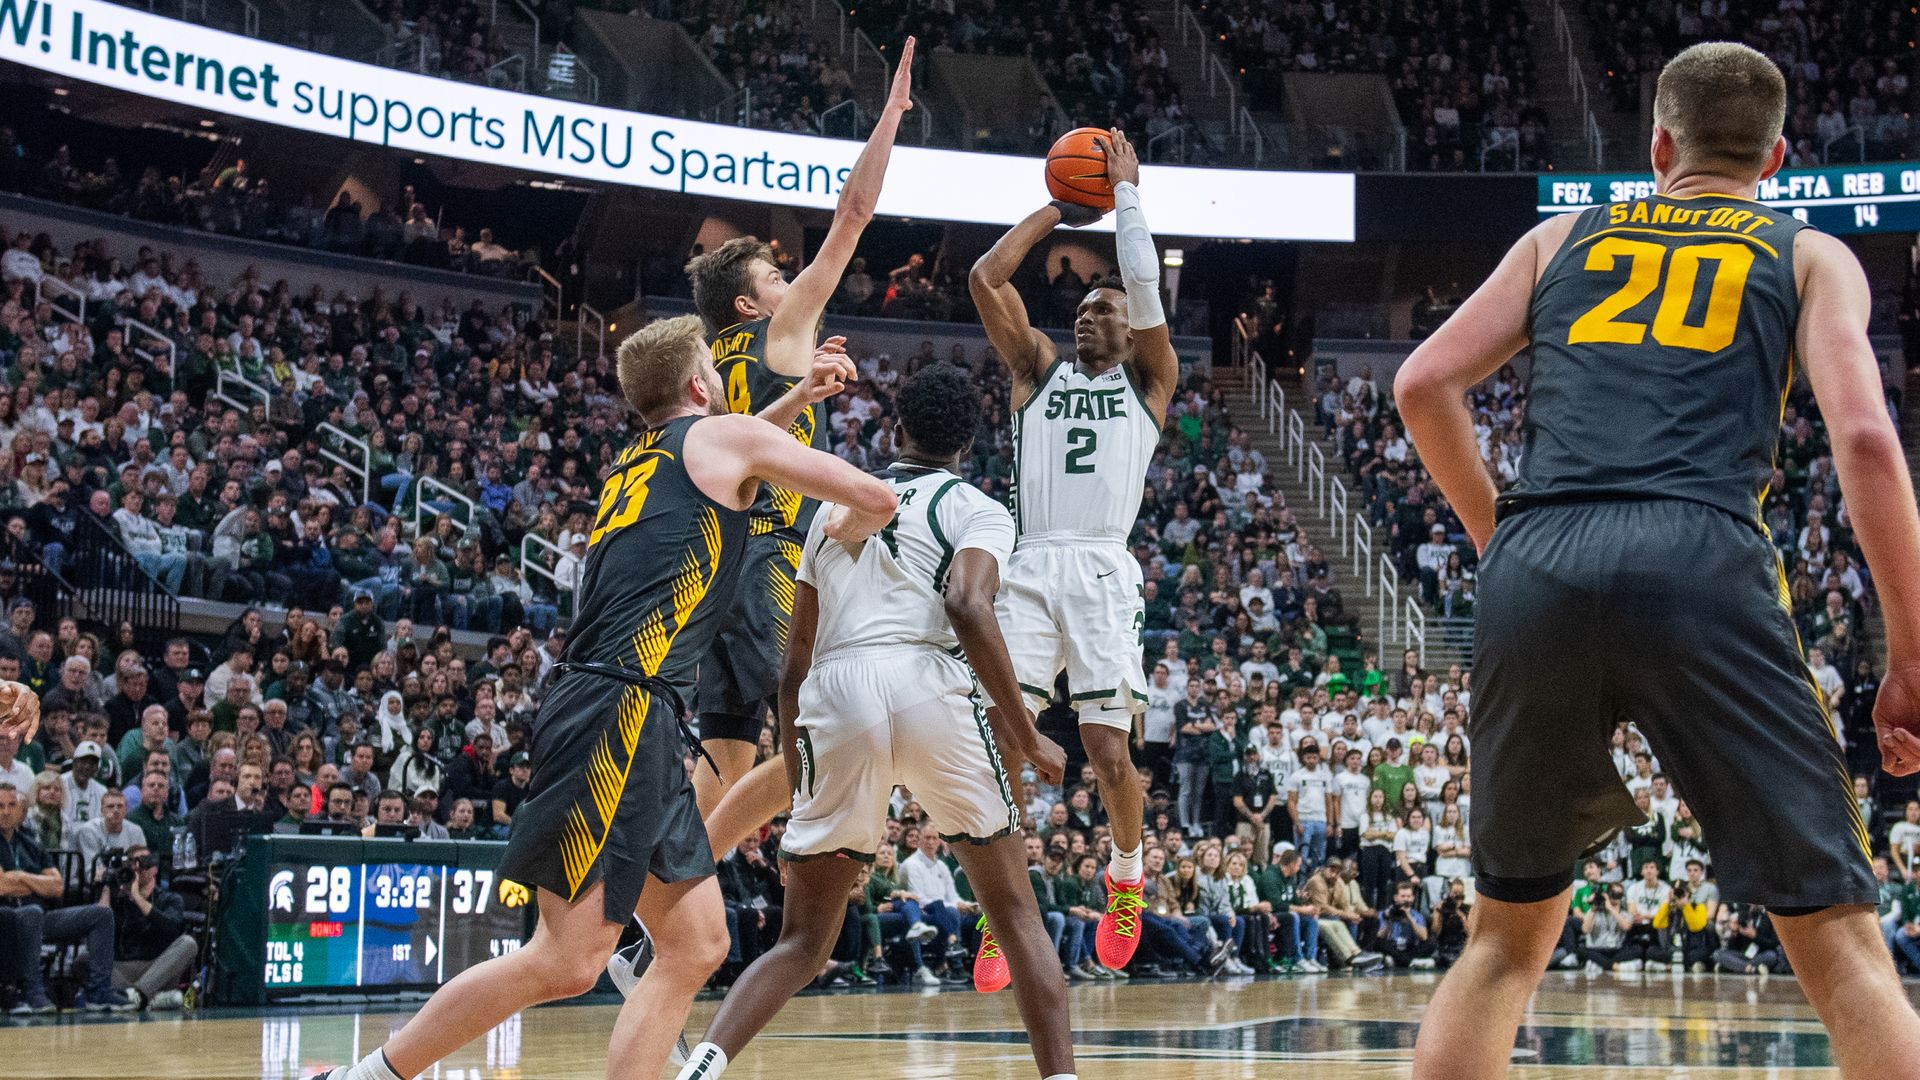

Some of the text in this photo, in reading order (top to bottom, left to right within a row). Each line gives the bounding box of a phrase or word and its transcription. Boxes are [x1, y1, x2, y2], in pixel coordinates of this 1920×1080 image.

[71, 11, 280, 107] Internet
[293, 81, 505, 149] supports
[523, 110, 632, 168] MSU
[1552, 182, 1593, 204] FG%
[1843, 172, 1884, 196] REB
[1854, 204, 1879, 227] 14
[1567, 236, 1756, 353] 20
[1044, 386, 1128, 421] STATE
[1065, 427, 1097, 474] 2
[588, 456, 659, 548] 23
[306, 866, 350, 913] 28
[376, 875, 431, 908] 3:32
[453, 869, 493, 914] 37
[311, 923, 341, 936] BONUS
[266, 941, 304, 961] TOL 4
[392, 944, 411, 961] 1ST
[490, 939, 499, 957] 4
[265, 962, 303, 983] FLS 6
